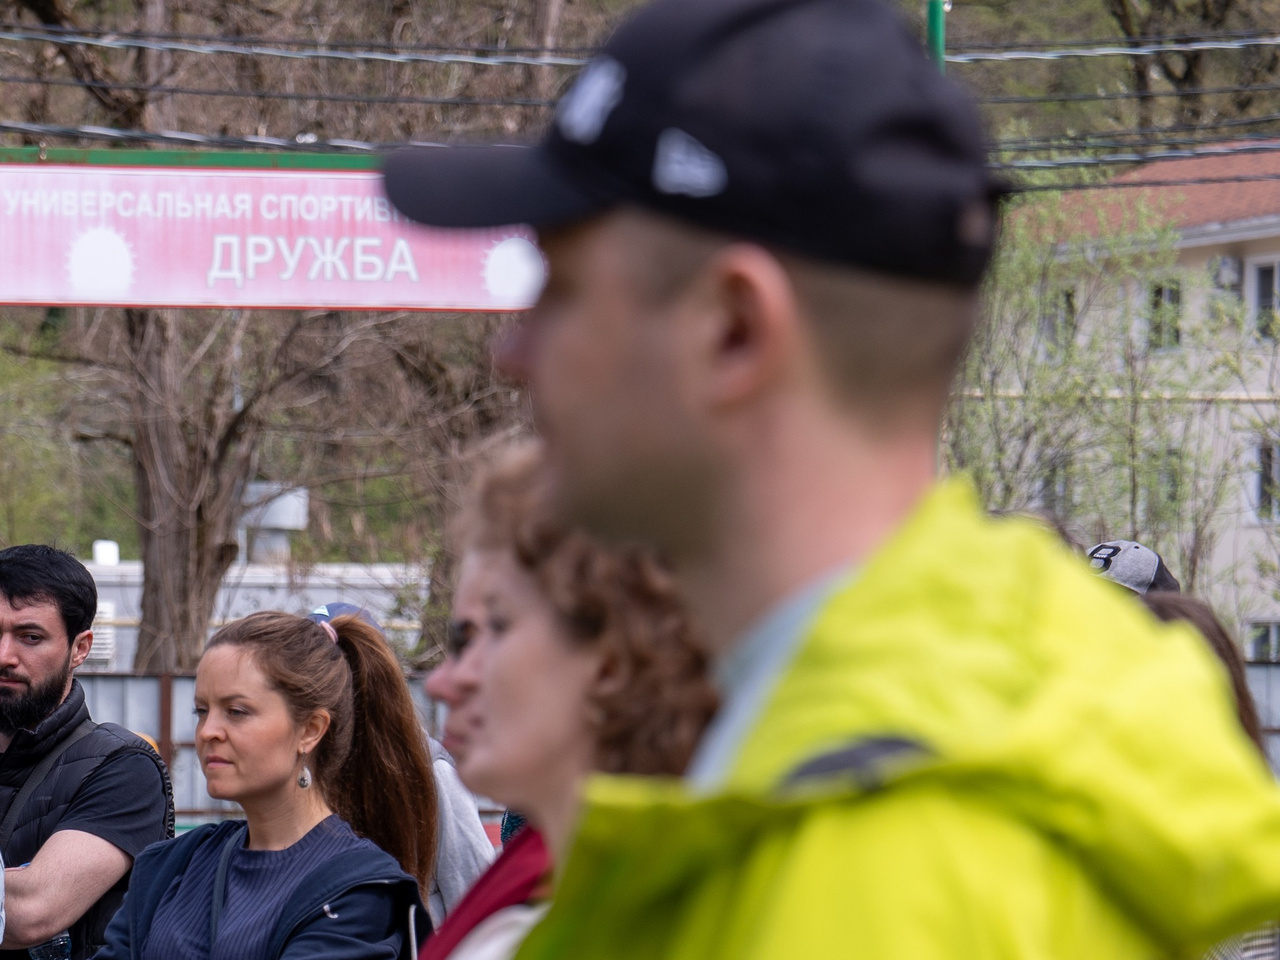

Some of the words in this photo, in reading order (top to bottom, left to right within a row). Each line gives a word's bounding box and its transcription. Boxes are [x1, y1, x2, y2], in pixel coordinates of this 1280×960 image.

[3, 188, 253, 221] УНИВЕРСАЛЬНАЯ
[260, 191, 416, 224] СПОРТИВ
[207, 234, 420, 289] ДРУЖБА
